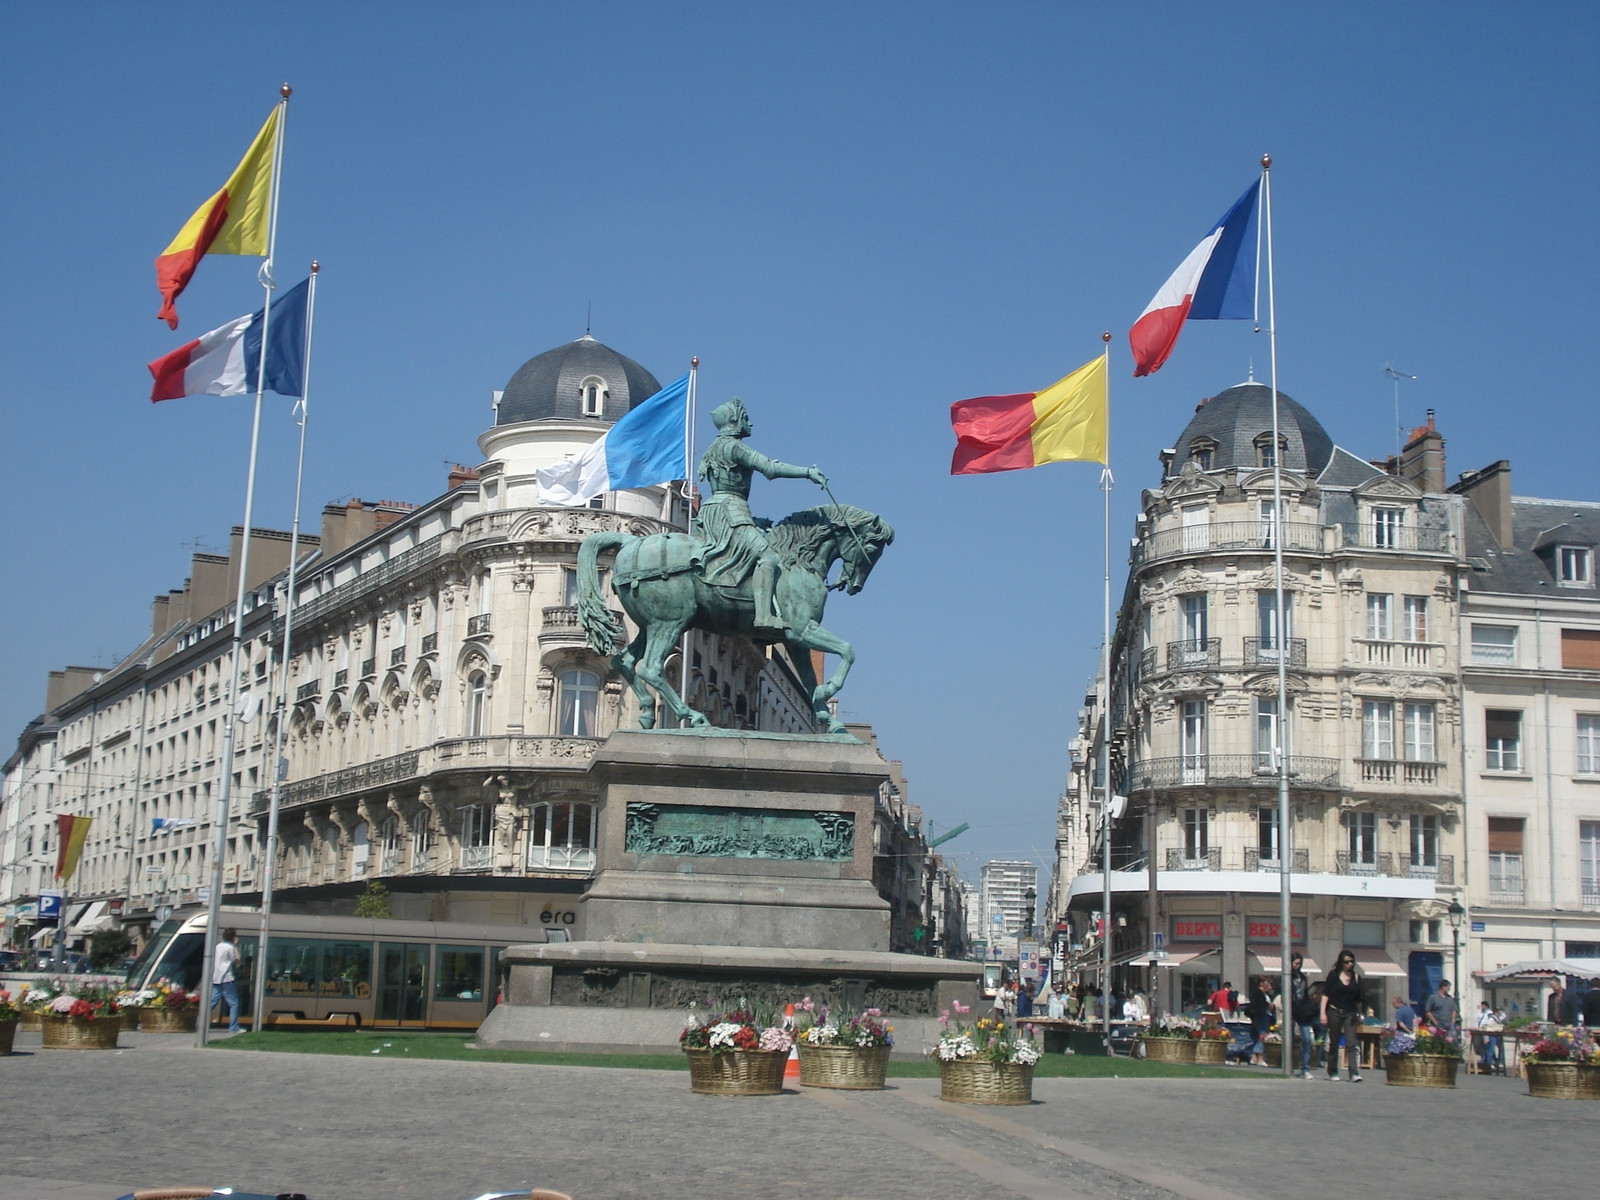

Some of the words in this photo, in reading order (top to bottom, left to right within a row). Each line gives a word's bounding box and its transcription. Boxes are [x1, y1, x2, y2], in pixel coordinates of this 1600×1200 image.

[40, 897, 53, 911] P
[1176, 922, 1221, 936] BERYL
[1248, 923, 1301, 938] BERL
